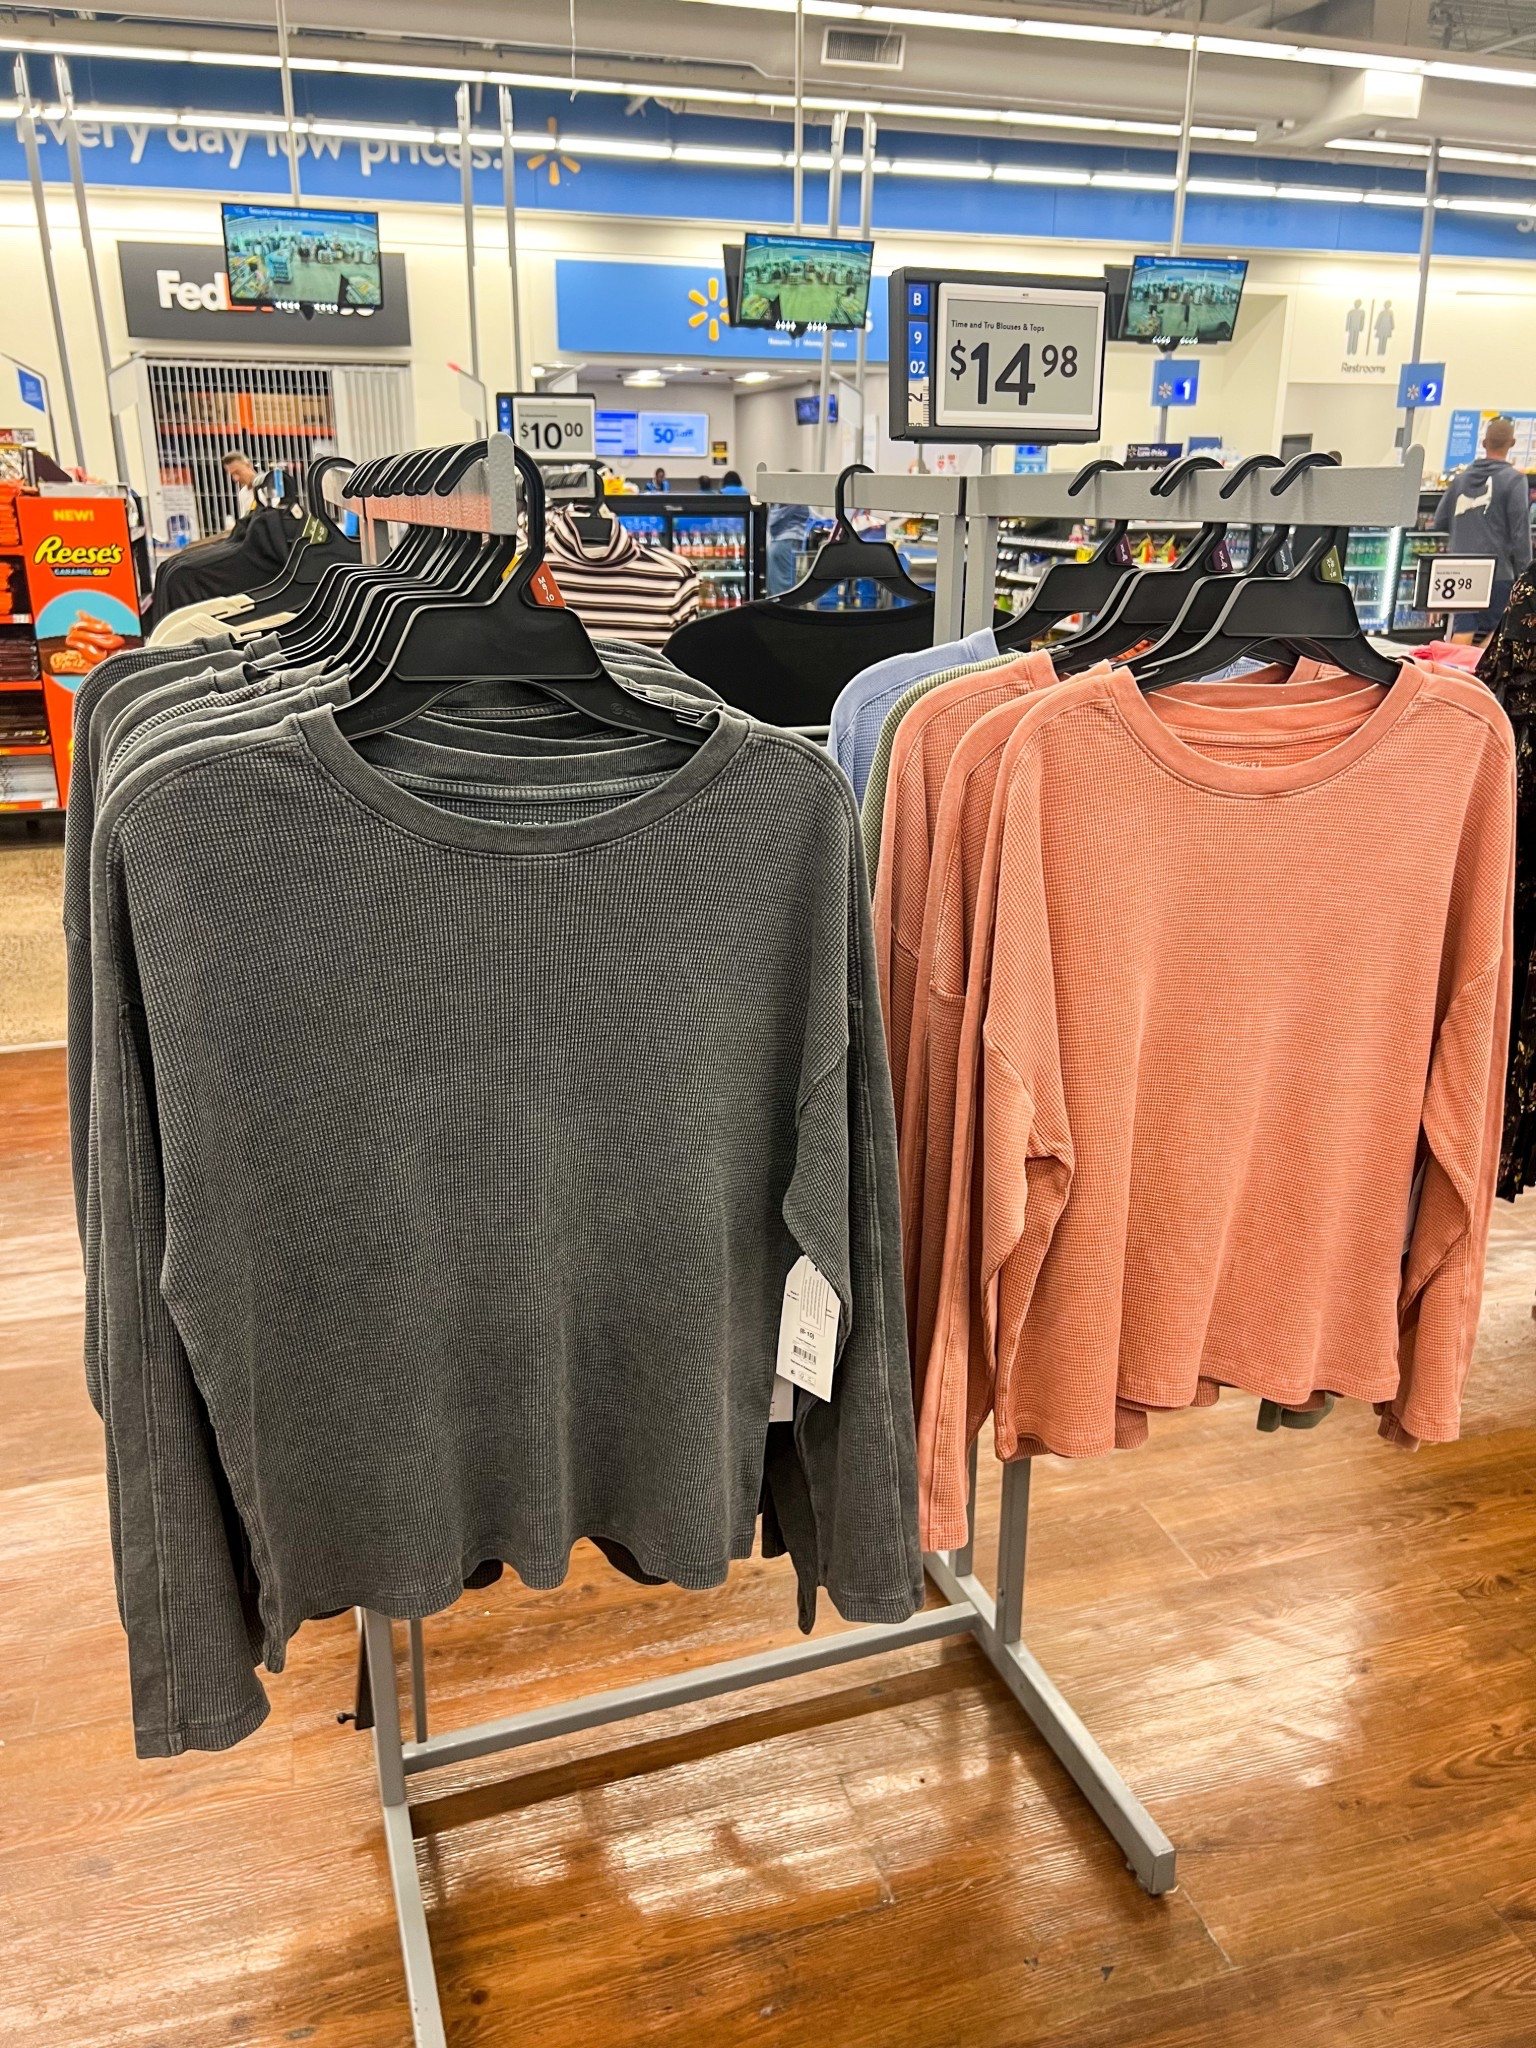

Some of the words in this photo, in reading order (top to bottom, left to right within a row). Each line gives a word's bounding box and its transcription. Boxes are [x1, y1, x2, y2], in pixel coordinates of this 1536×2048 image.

[167, 123, 248, 169] day
[157, 270, 275, 313] Fed
[914, 293, 922, 306] B
[951, 319, 968, 328] Time
[969, 321, 982, 329] and
[984, 321, 995, 329] Tru
[996, 322, 1021, 331] Blouses
[1023, 323, 1028, 331] &
[1030, 323, 1045, 333] Tops
[914, 331, 922, 344] 9
[910, 361, 926, 374] 02
[1341, 362, 1386, 373] Restrooms
[1183, 378, 1191, 400] 1
[1425, 382, 1437, 401] 2
[654, 428, 674, 443] 50
[53, 509, 94, 521] NEW!
[34, 535, 124, 565] Reese's
